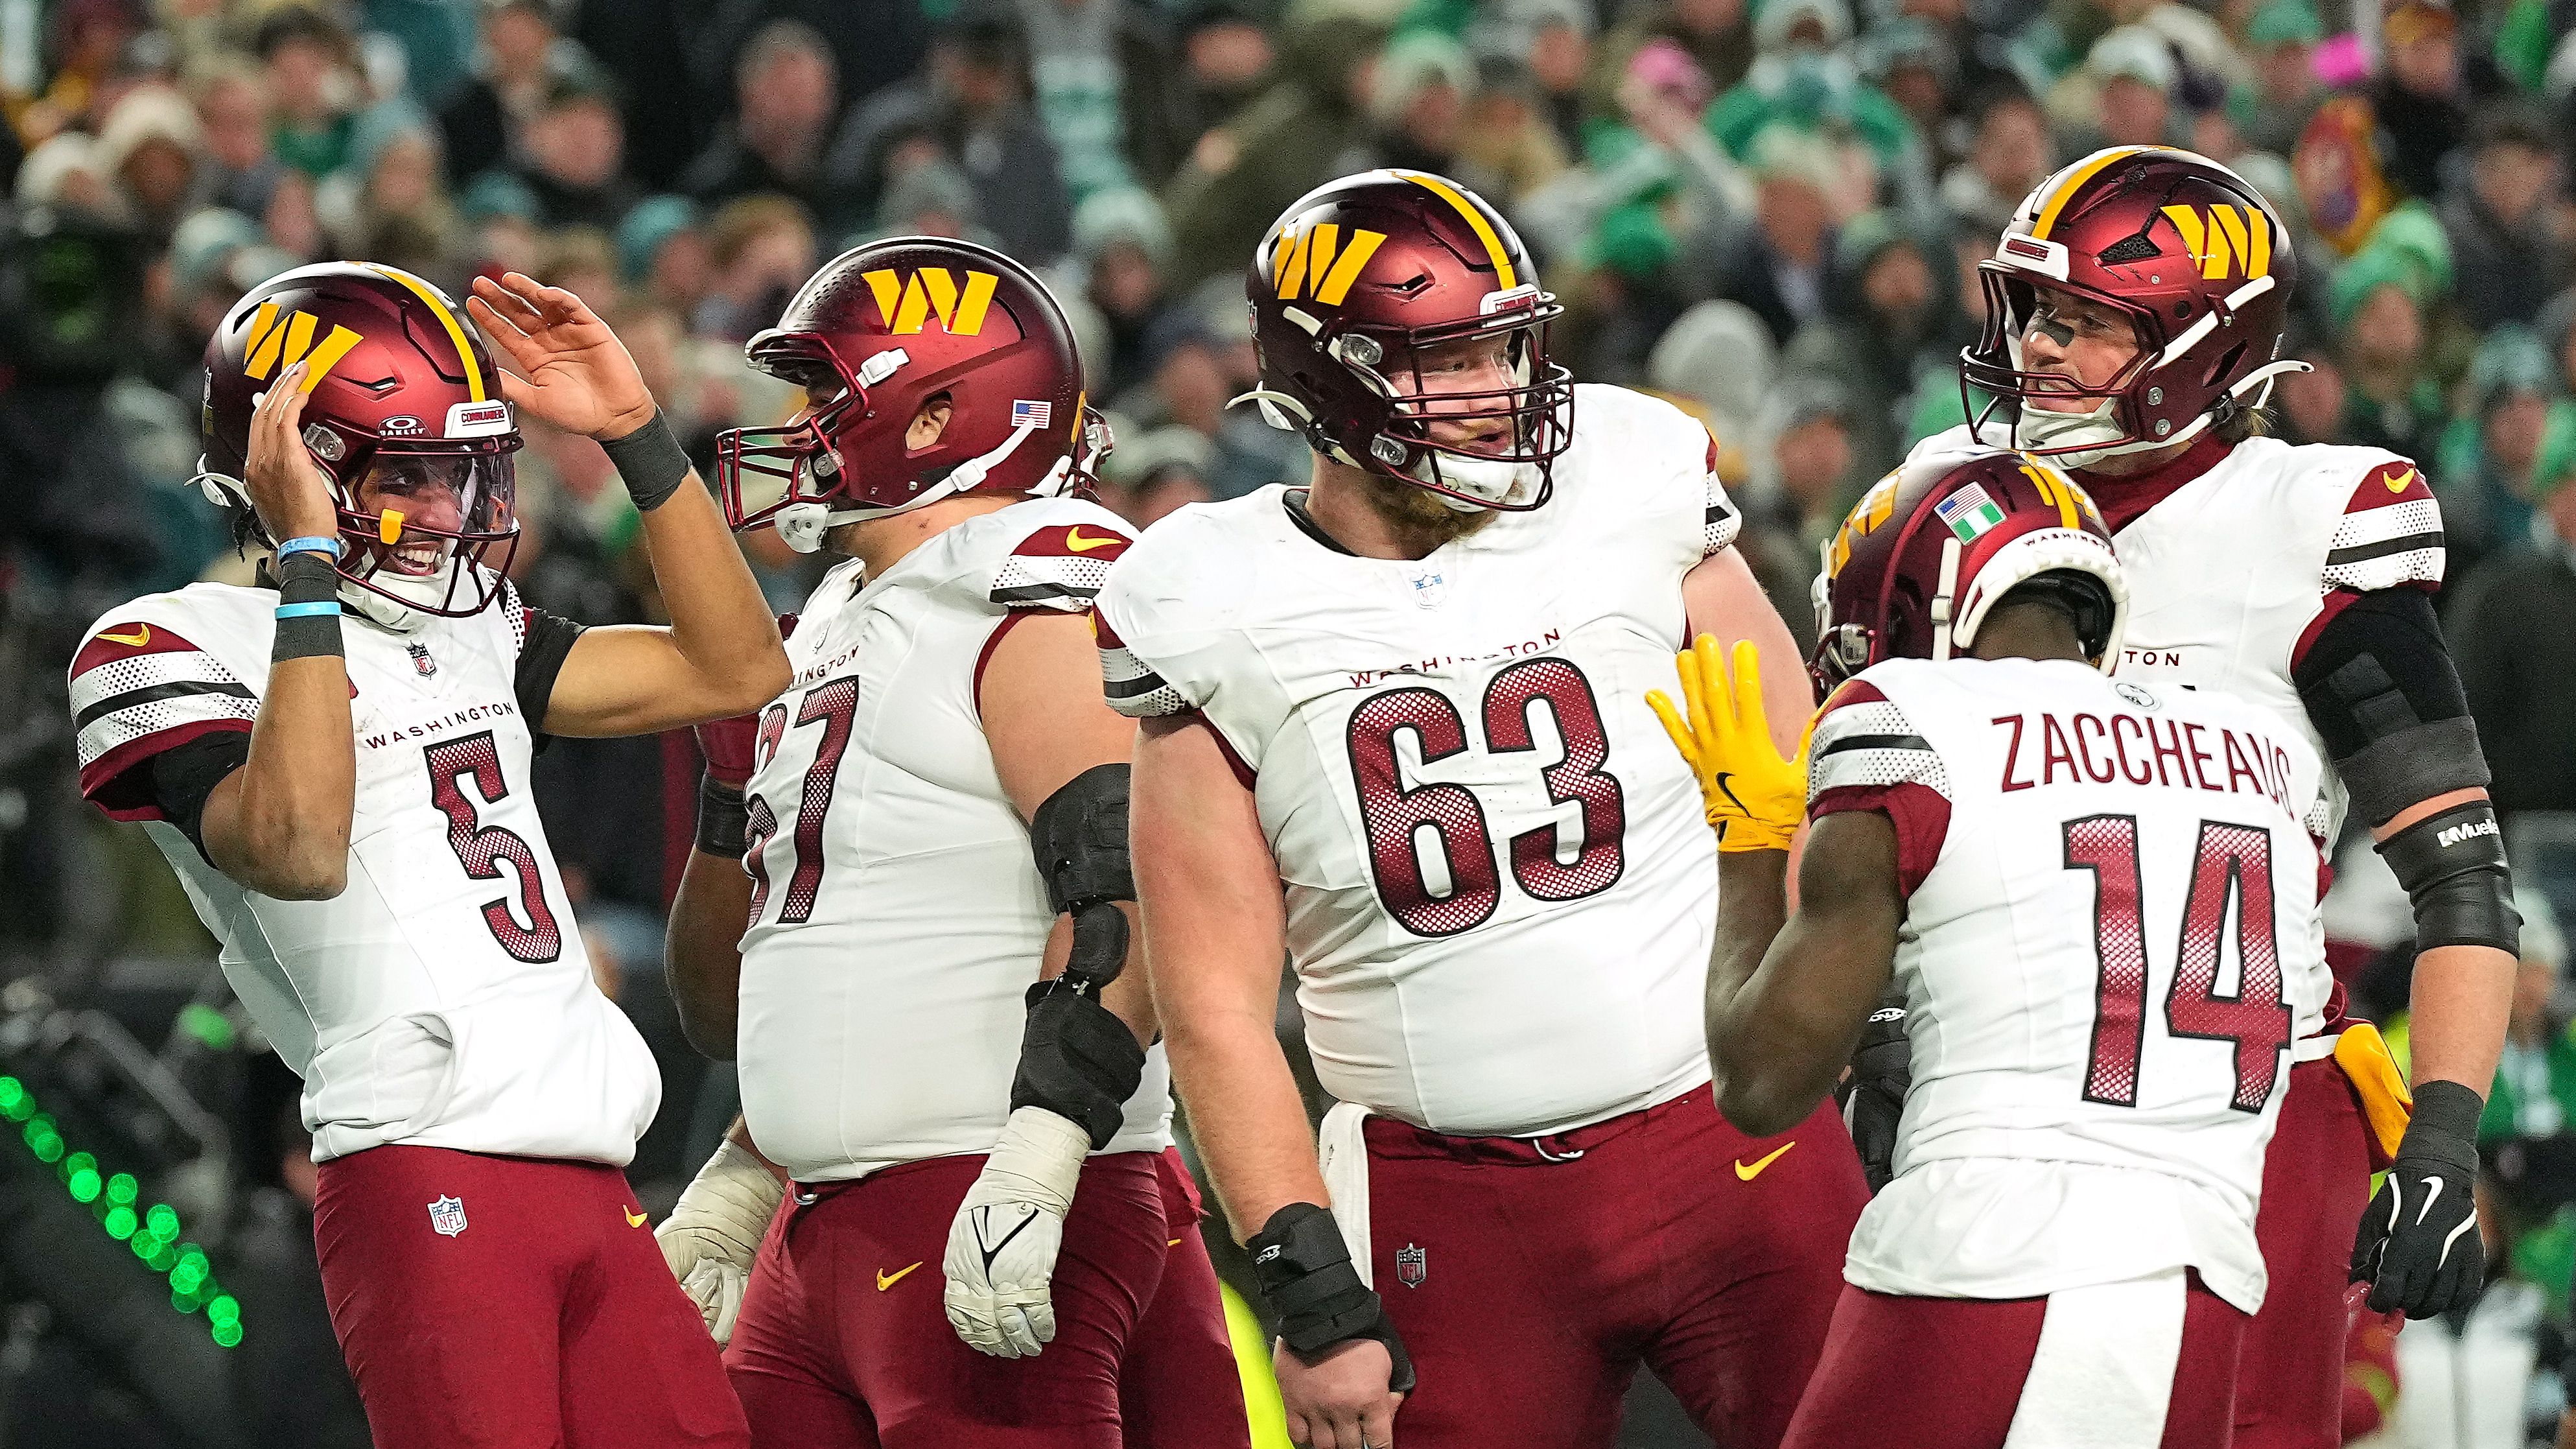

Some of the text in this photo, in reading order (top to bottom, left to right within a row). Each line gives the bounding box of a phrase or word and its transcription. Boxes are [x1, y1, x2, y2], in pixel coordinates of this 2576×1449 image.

[379, 427, 425, 436] OAKLEY
[365, 701, 514, 749] WASHINGTON
[1991, 713, 2295, 821] ZACCHEAUS
[423, 729, 562, 964] 5
[1346, 657, 1626, 937] 63
[2061, 813, 2294, 1116] 14
[438, 1212, 462, 1229] NFL
